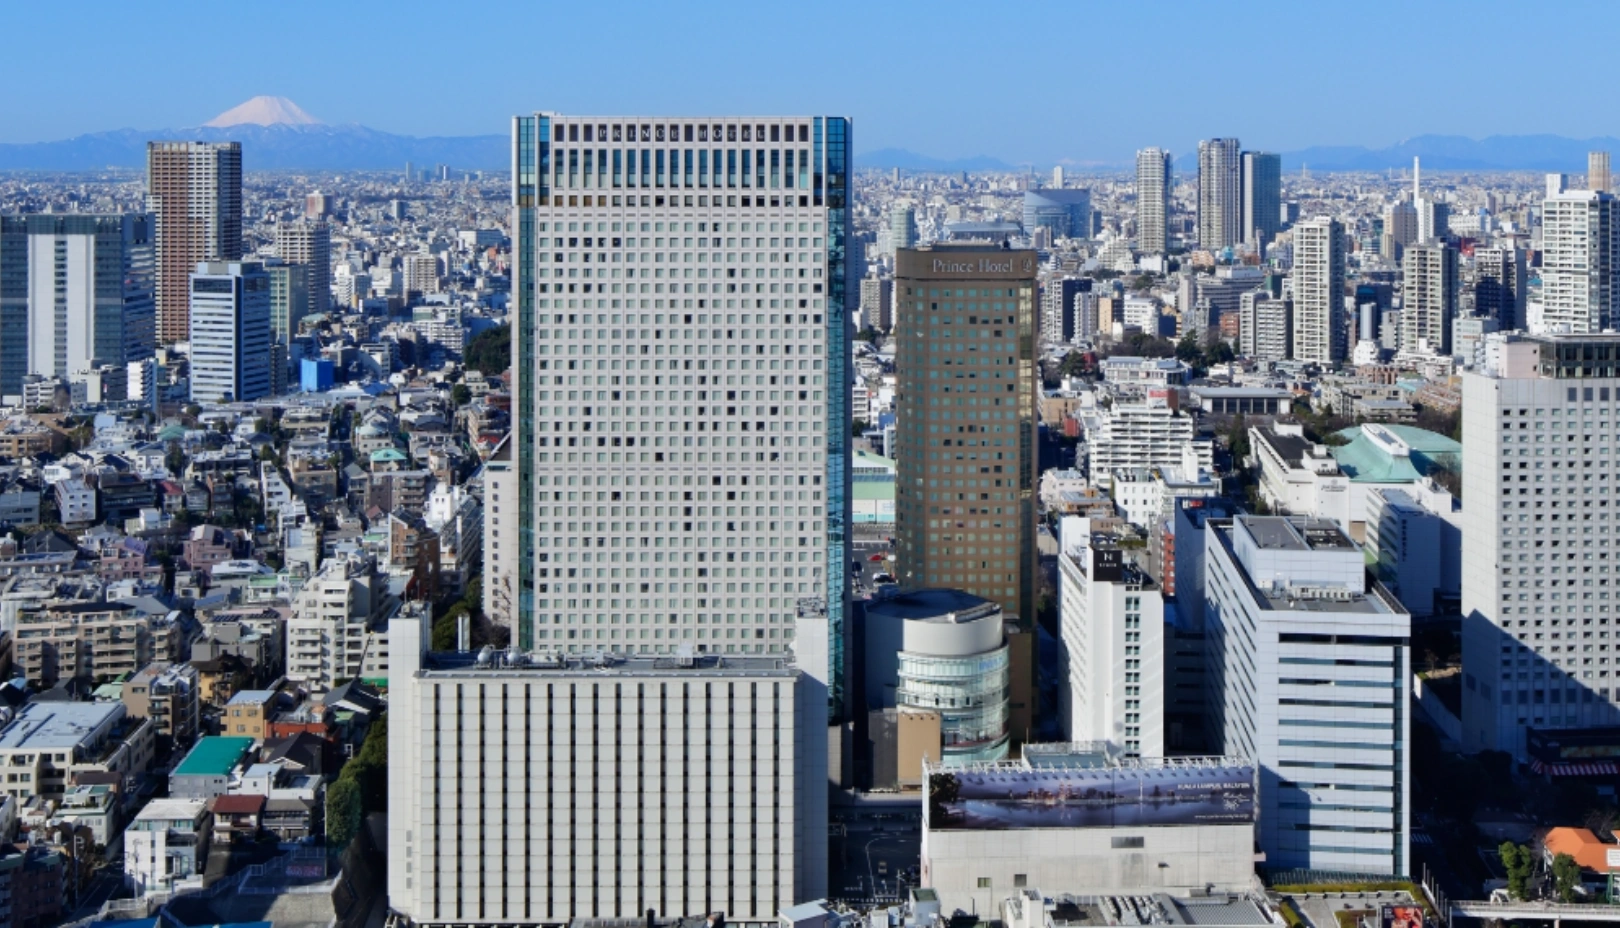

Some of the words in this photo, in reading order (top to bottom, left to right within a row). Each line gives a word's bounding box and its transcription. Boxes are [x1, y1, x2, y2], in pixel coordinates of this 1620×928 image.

[599, 128, 680, 139] PRINCE
[698, 128, 764, 139] HOTEL
[933, 258, 974, 273] Prince
[979, 258, 1013, 273] Hotel
